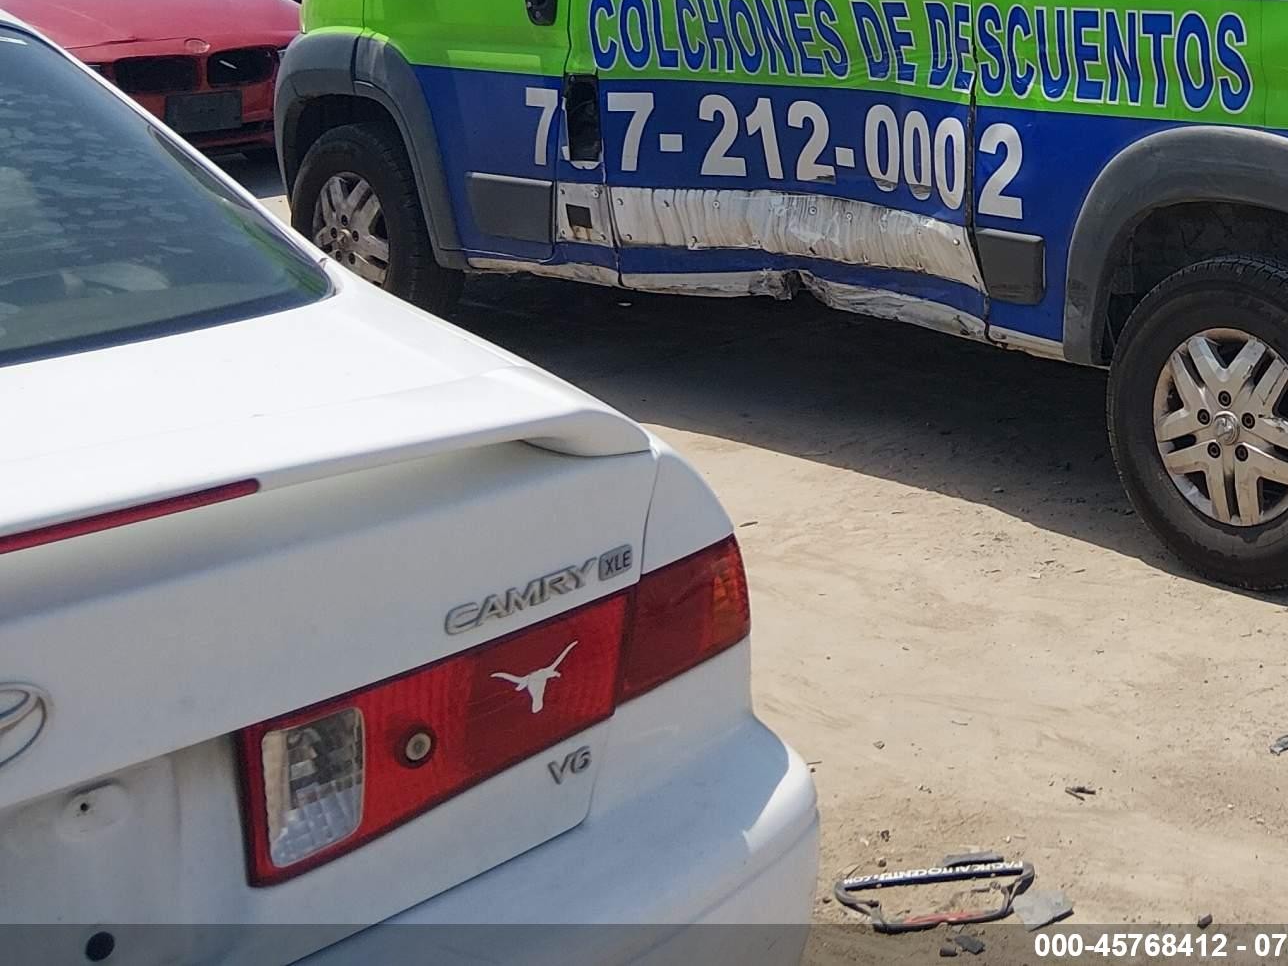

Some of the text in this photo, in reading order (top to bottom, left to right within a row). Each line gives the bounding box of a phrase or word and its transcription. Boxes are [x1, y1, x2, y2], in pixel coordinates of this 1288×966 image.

[852, 0, 917, 84] DE
[925, 1, 1254, 114] DESCUENTOS
[525, 86, 1023, 220] 77-212-0002
[444, 549, 633, 636] CAMRY XLE
[547, 745, 592, 785] V6
